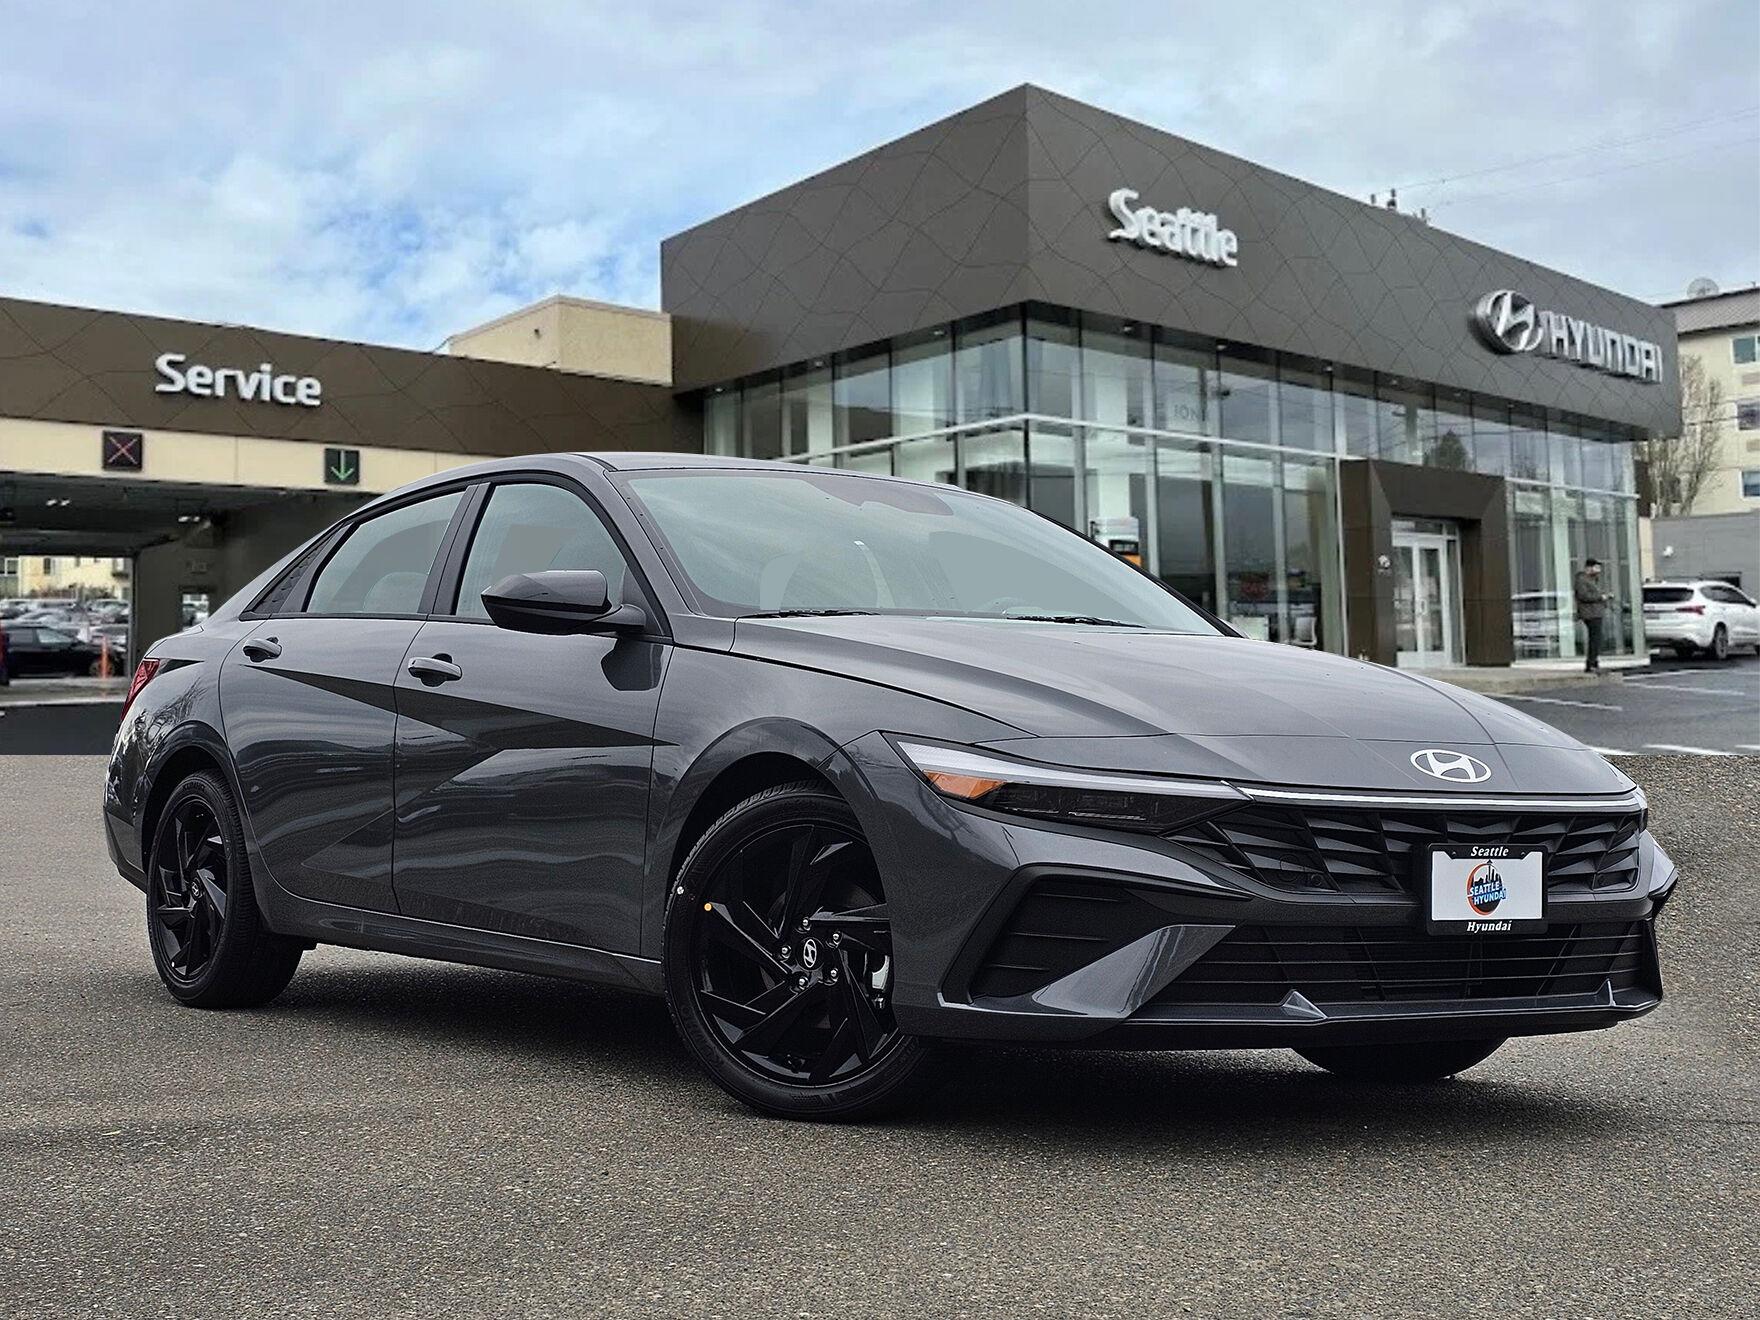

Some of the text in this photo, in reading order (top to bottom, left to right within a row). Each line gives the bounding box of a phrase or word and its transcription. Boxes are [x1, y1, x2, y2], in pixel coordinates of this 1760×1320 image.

[1108, 188, 1238, 266] Seattle
[1541, 310, 1664, 382] HYUNDAI
[155, 353, 322, 406] Service
[1470, 846, 1509, 857] Seattle
[1469, 881, 1501, 896] SEATTLE
[1473, 888, 1507, 906] HYUNDAI
[1466, 920, 1512, 933] Hyundai
